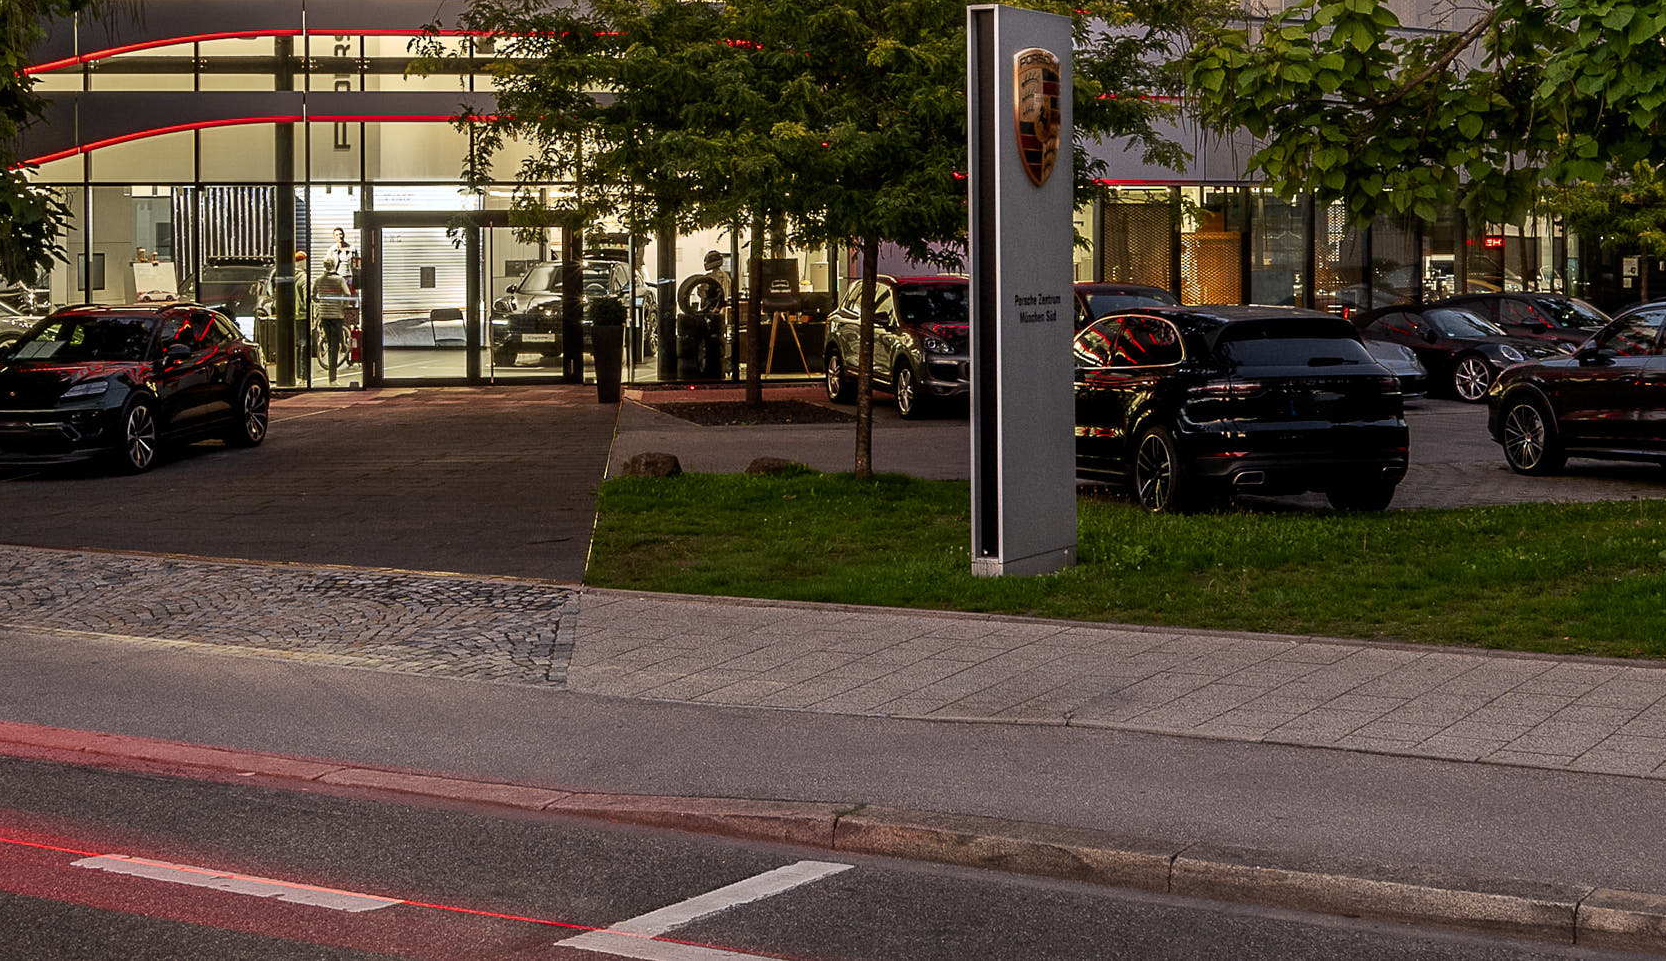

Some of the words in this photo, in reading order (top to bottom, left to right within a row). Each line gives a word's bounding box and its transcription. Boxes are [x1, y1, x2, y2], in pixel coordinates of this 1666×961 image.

[1015, 293, 1037, 306] Porsche
[1038, 293, 1061, 305] Zentrum
[1020, 310, 1045, 323] München
[1046, 310, 1056, 322] Süd
